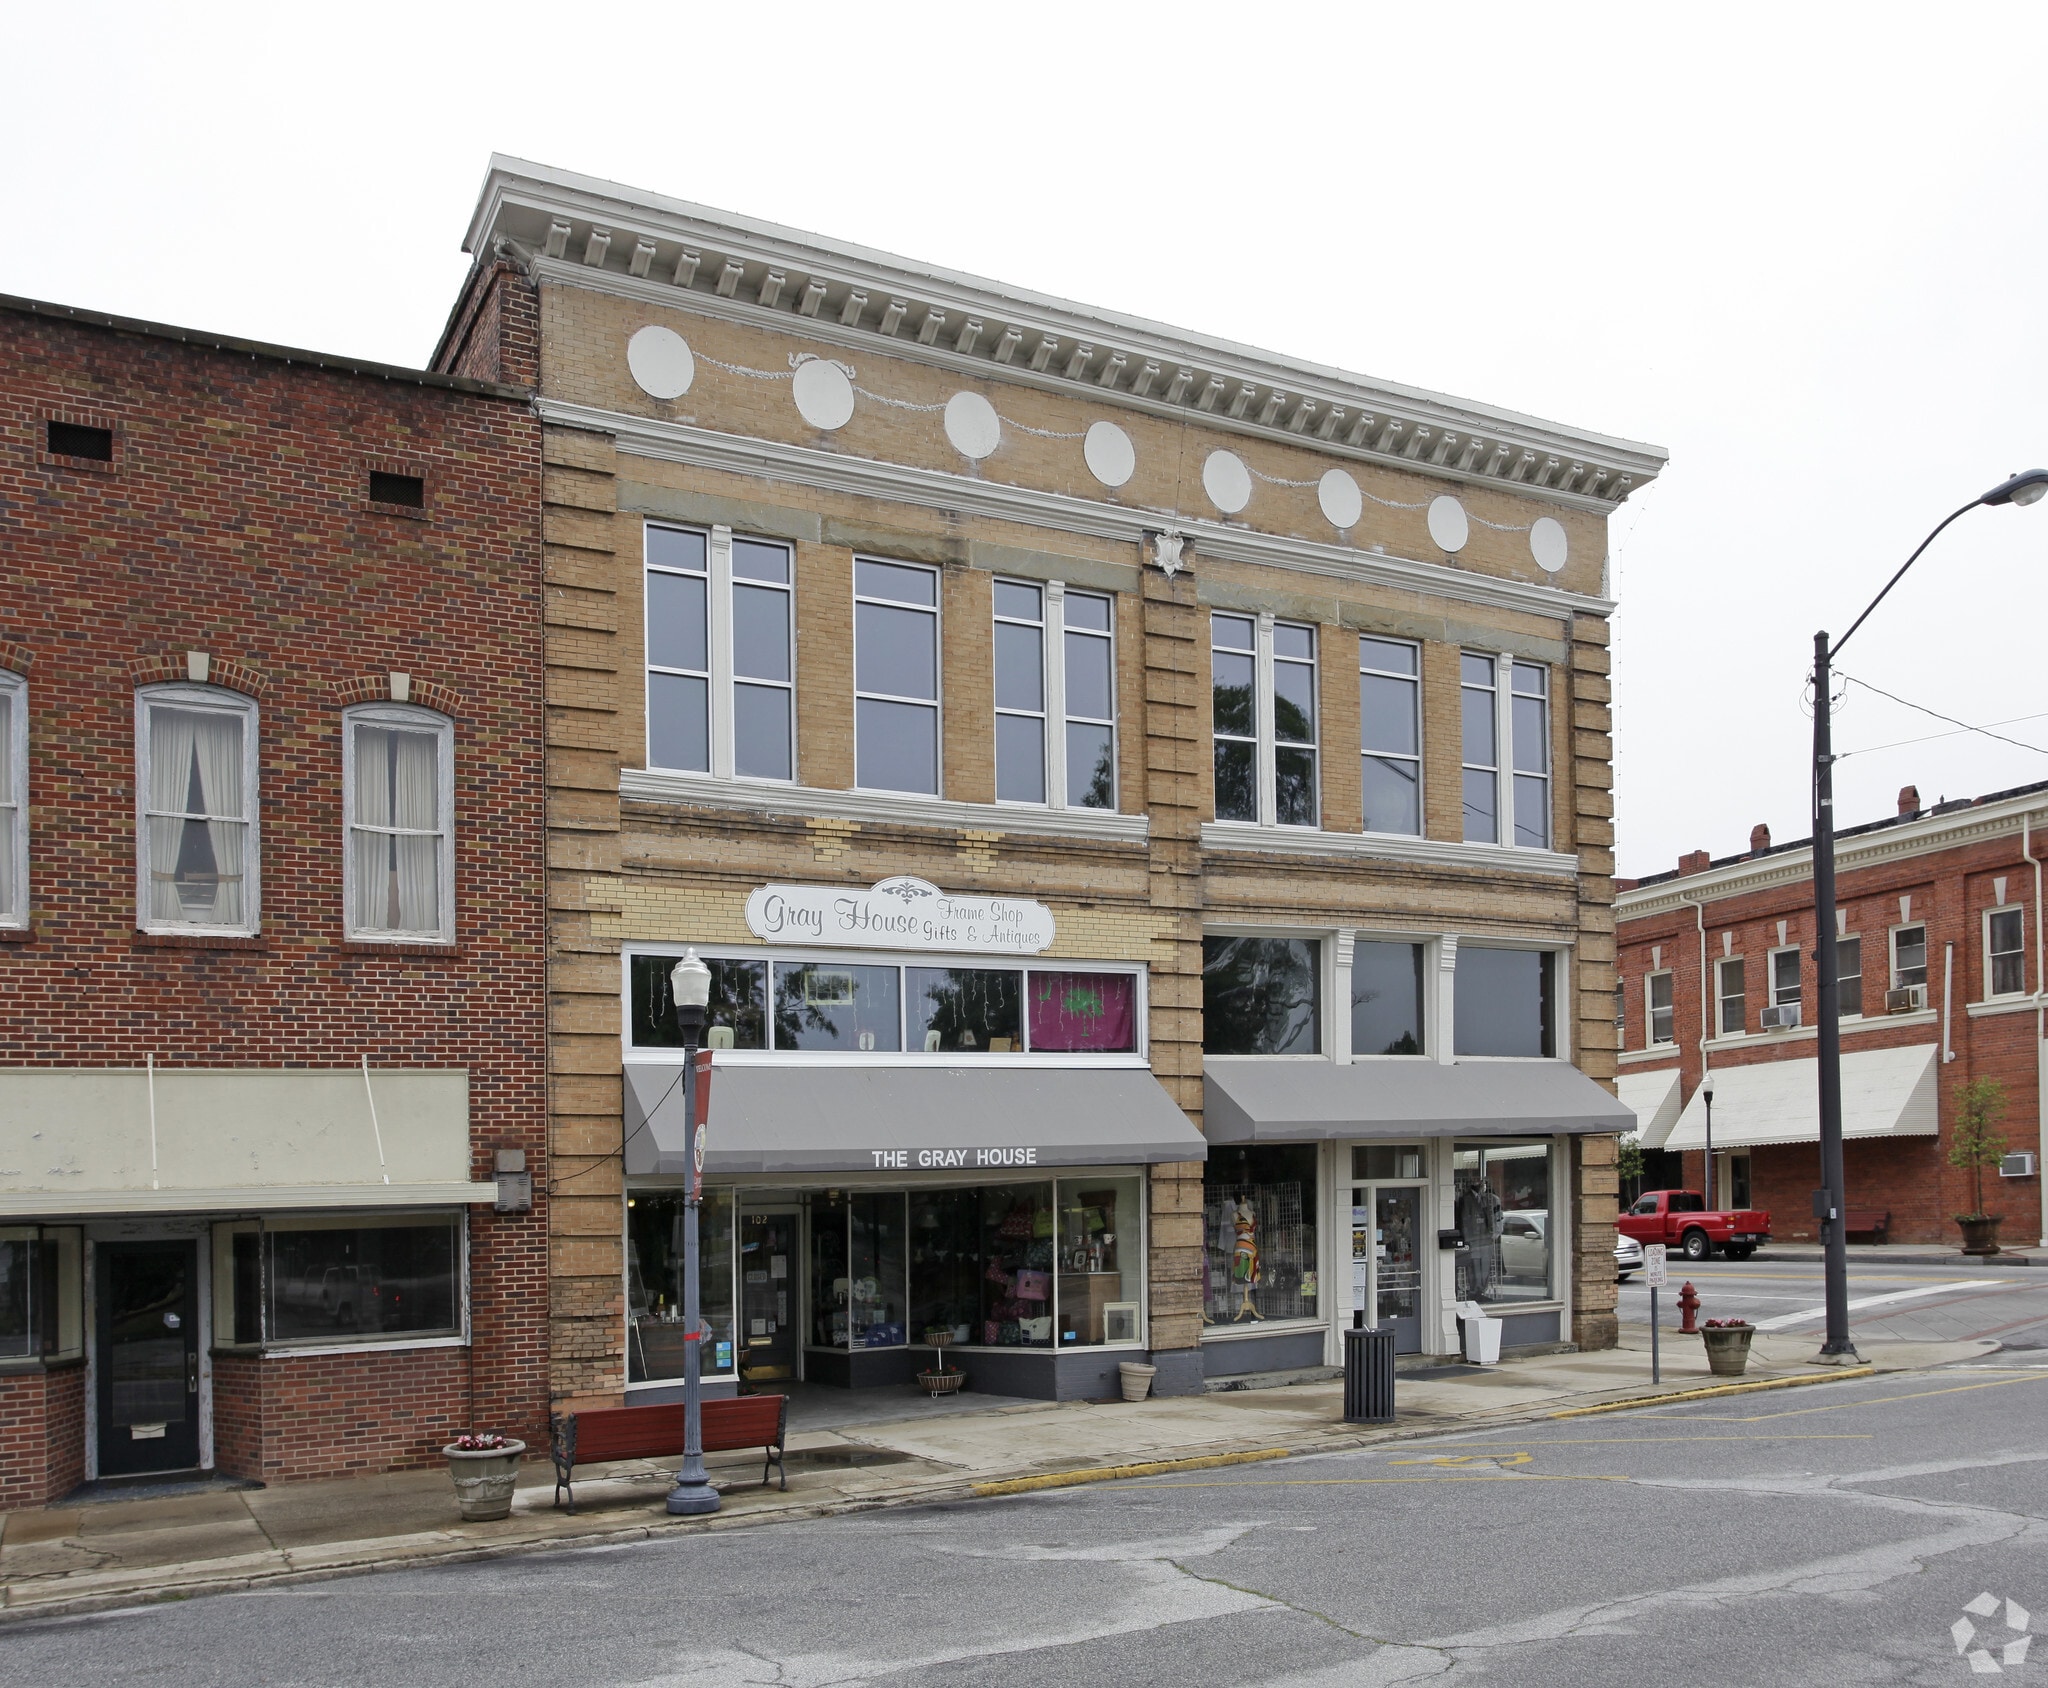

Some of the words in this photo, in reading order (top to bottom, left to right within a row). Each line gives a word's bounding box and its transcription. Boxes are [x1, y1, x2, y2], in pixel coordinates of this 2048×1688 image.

[764, 894, 823, 937] Gray
[833, 898, 918, 934] House
[936, 898, 985, 920] Frame
[990, 901, 1024, 928] Shop
[923, 920, 957, 941] Gifts
[967, 925, 978, 942] &
[982, 924, 1041, 949] Antiques
[872, 1150, 908, 1168] THE
[918, 1149, 968, 1167] GRAY
[977, 1147, 1037, 1166] HOUSE
[751, 1215, 768, 1225] 102
[1648, 1247, 1664, 1257] LOADING
[1651, 1256, 1661, 1266] ZONE
